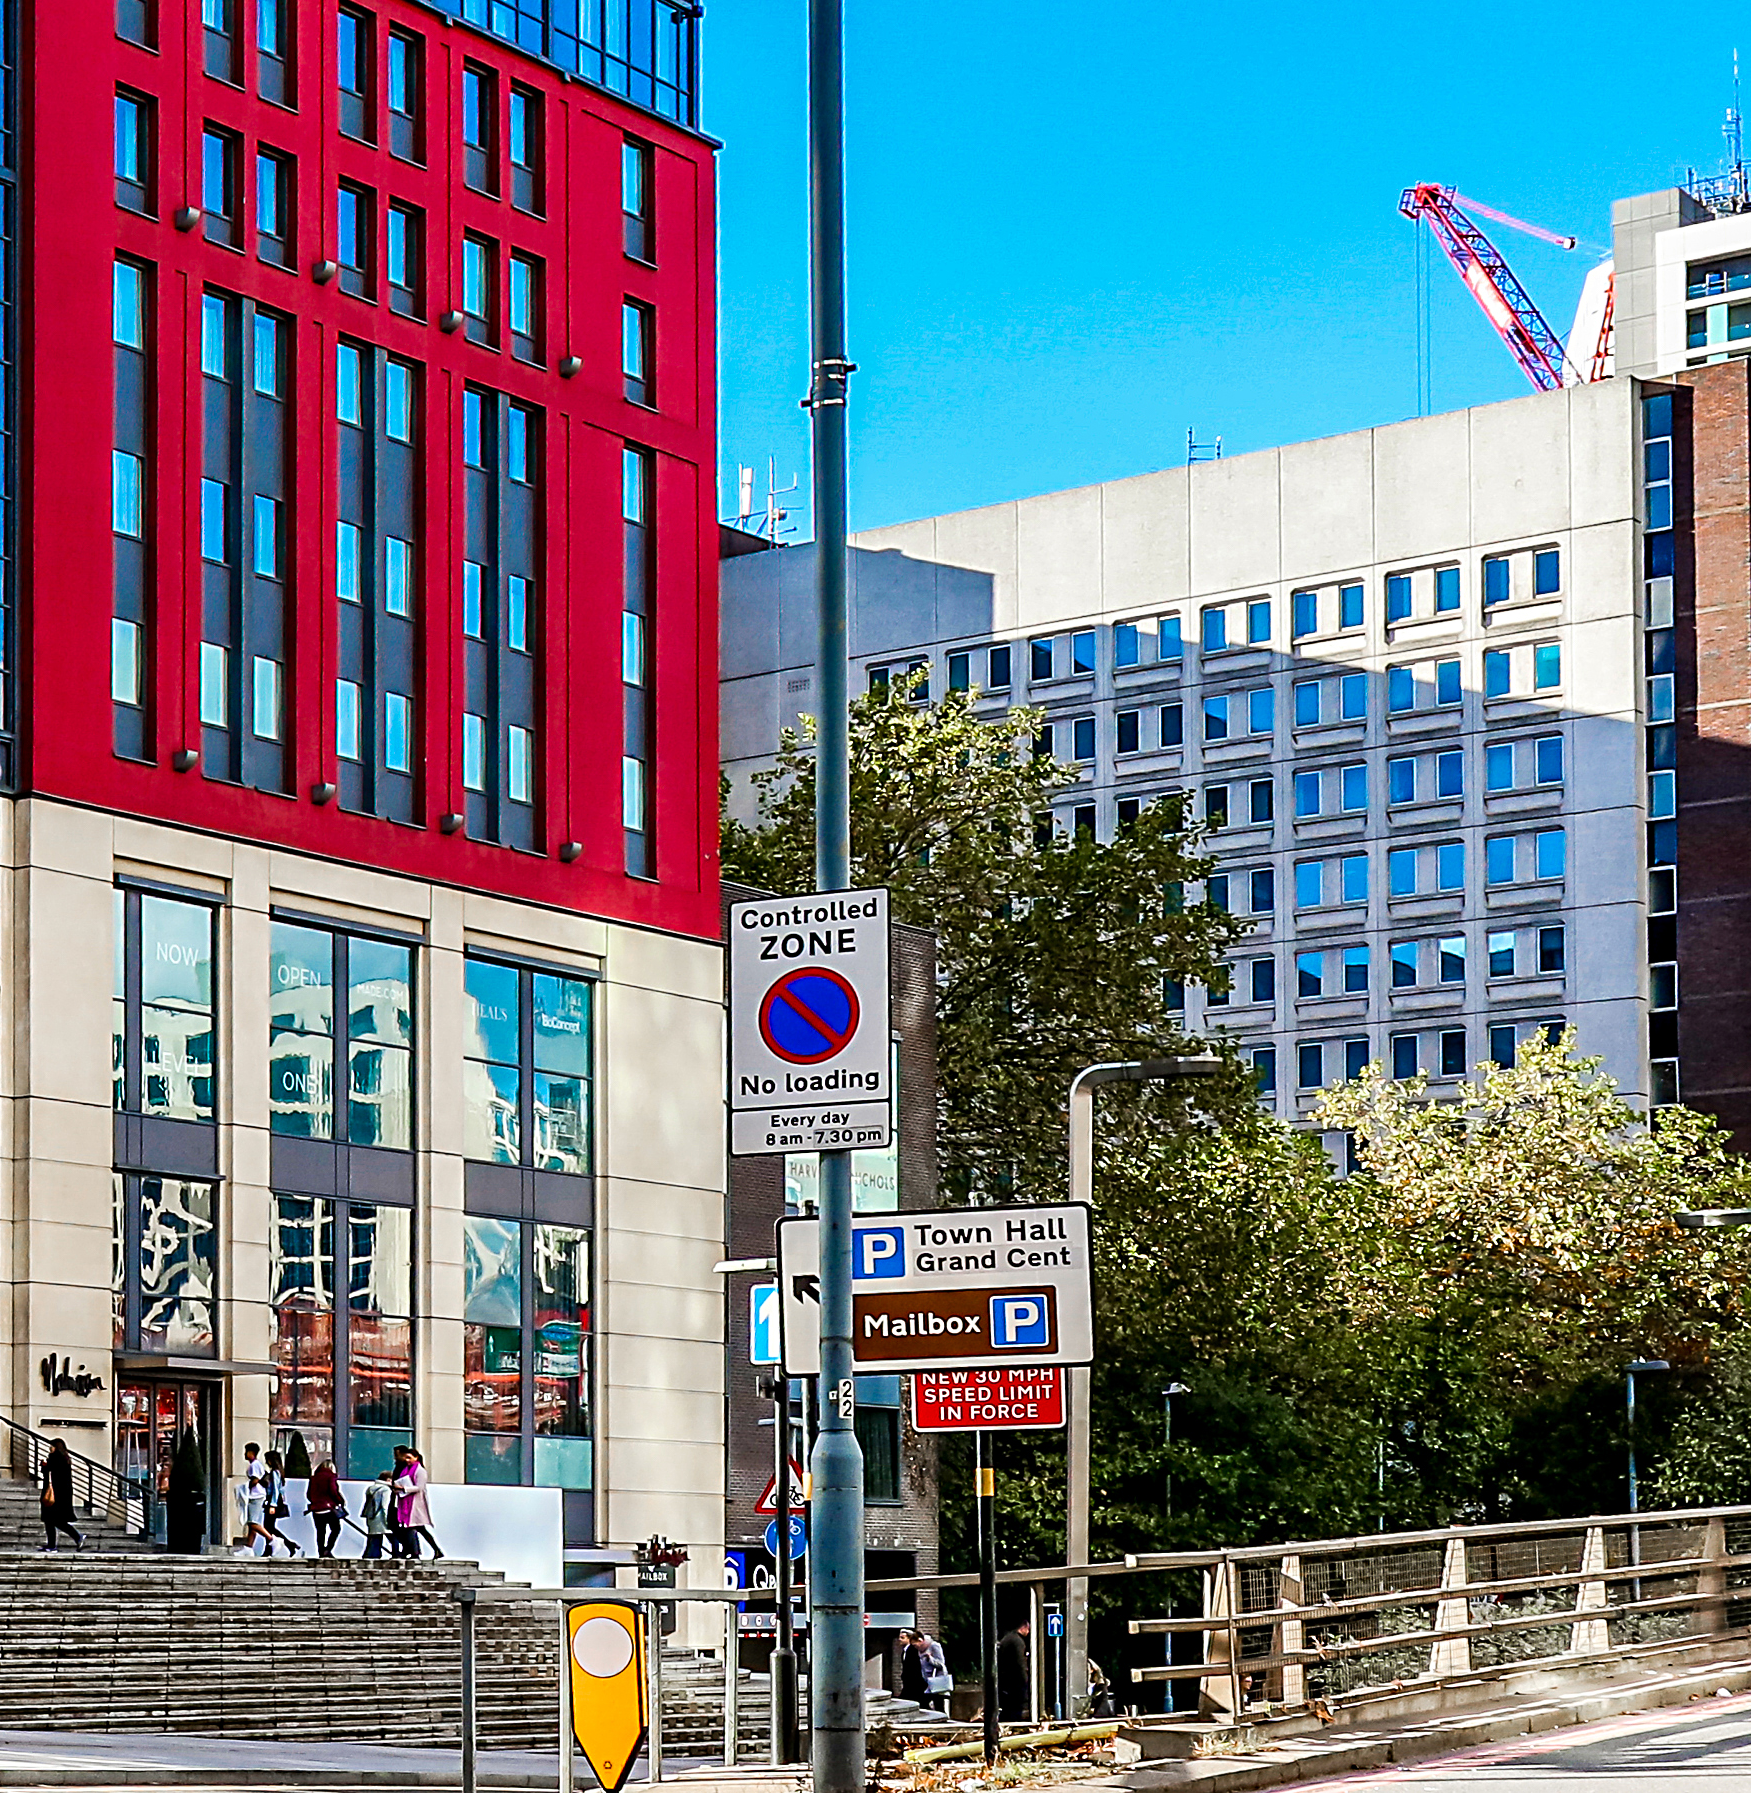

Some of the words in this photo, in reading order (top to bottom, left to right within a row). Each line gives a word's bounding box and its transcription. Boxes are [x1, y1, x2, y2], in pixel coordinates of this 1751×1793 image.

[741, 897, 877, 929] Controlled
[760, 928, 856, 960] ZONE
[156, 942, 199, 966] NOW
[278, 965, 321, 989] OPEN
[542, 1013, 581, 1035] BoConcept
[740, 1075, 776, 1095] No
[786, 1069, 879, 1093] loading
[771, 1114, 816, 1128] Every
[821, 1111, 850, 1125] day
[766, 1133, 775, 1145] 8
[779, 1133, 803, 1145] am
[814, 1129, 853, 1145] 7.30
[857, 1130, 882, 1144] pm
[914, 1224, 992, 1246] Town
[1006, 1218, 1067, 1242] Hall
[916, 1249, 996, 1272] Grand
[1007, 1247, 1071, 1268] Cent
[864, 1312, 981, 1338] Mailbox
[922, 1369, 971, 1385] NEW
[975, 1370, 1000, 1384] 30
[1009, 1368, 1054, 1384] MPH
[924, 1386, 991, 1403] SPEED
[999, 1384, 1054, 1401] LIMIT
[940, 1405, 961, 1421] IN
[970, 1403, 1039, 1420] FORCE
